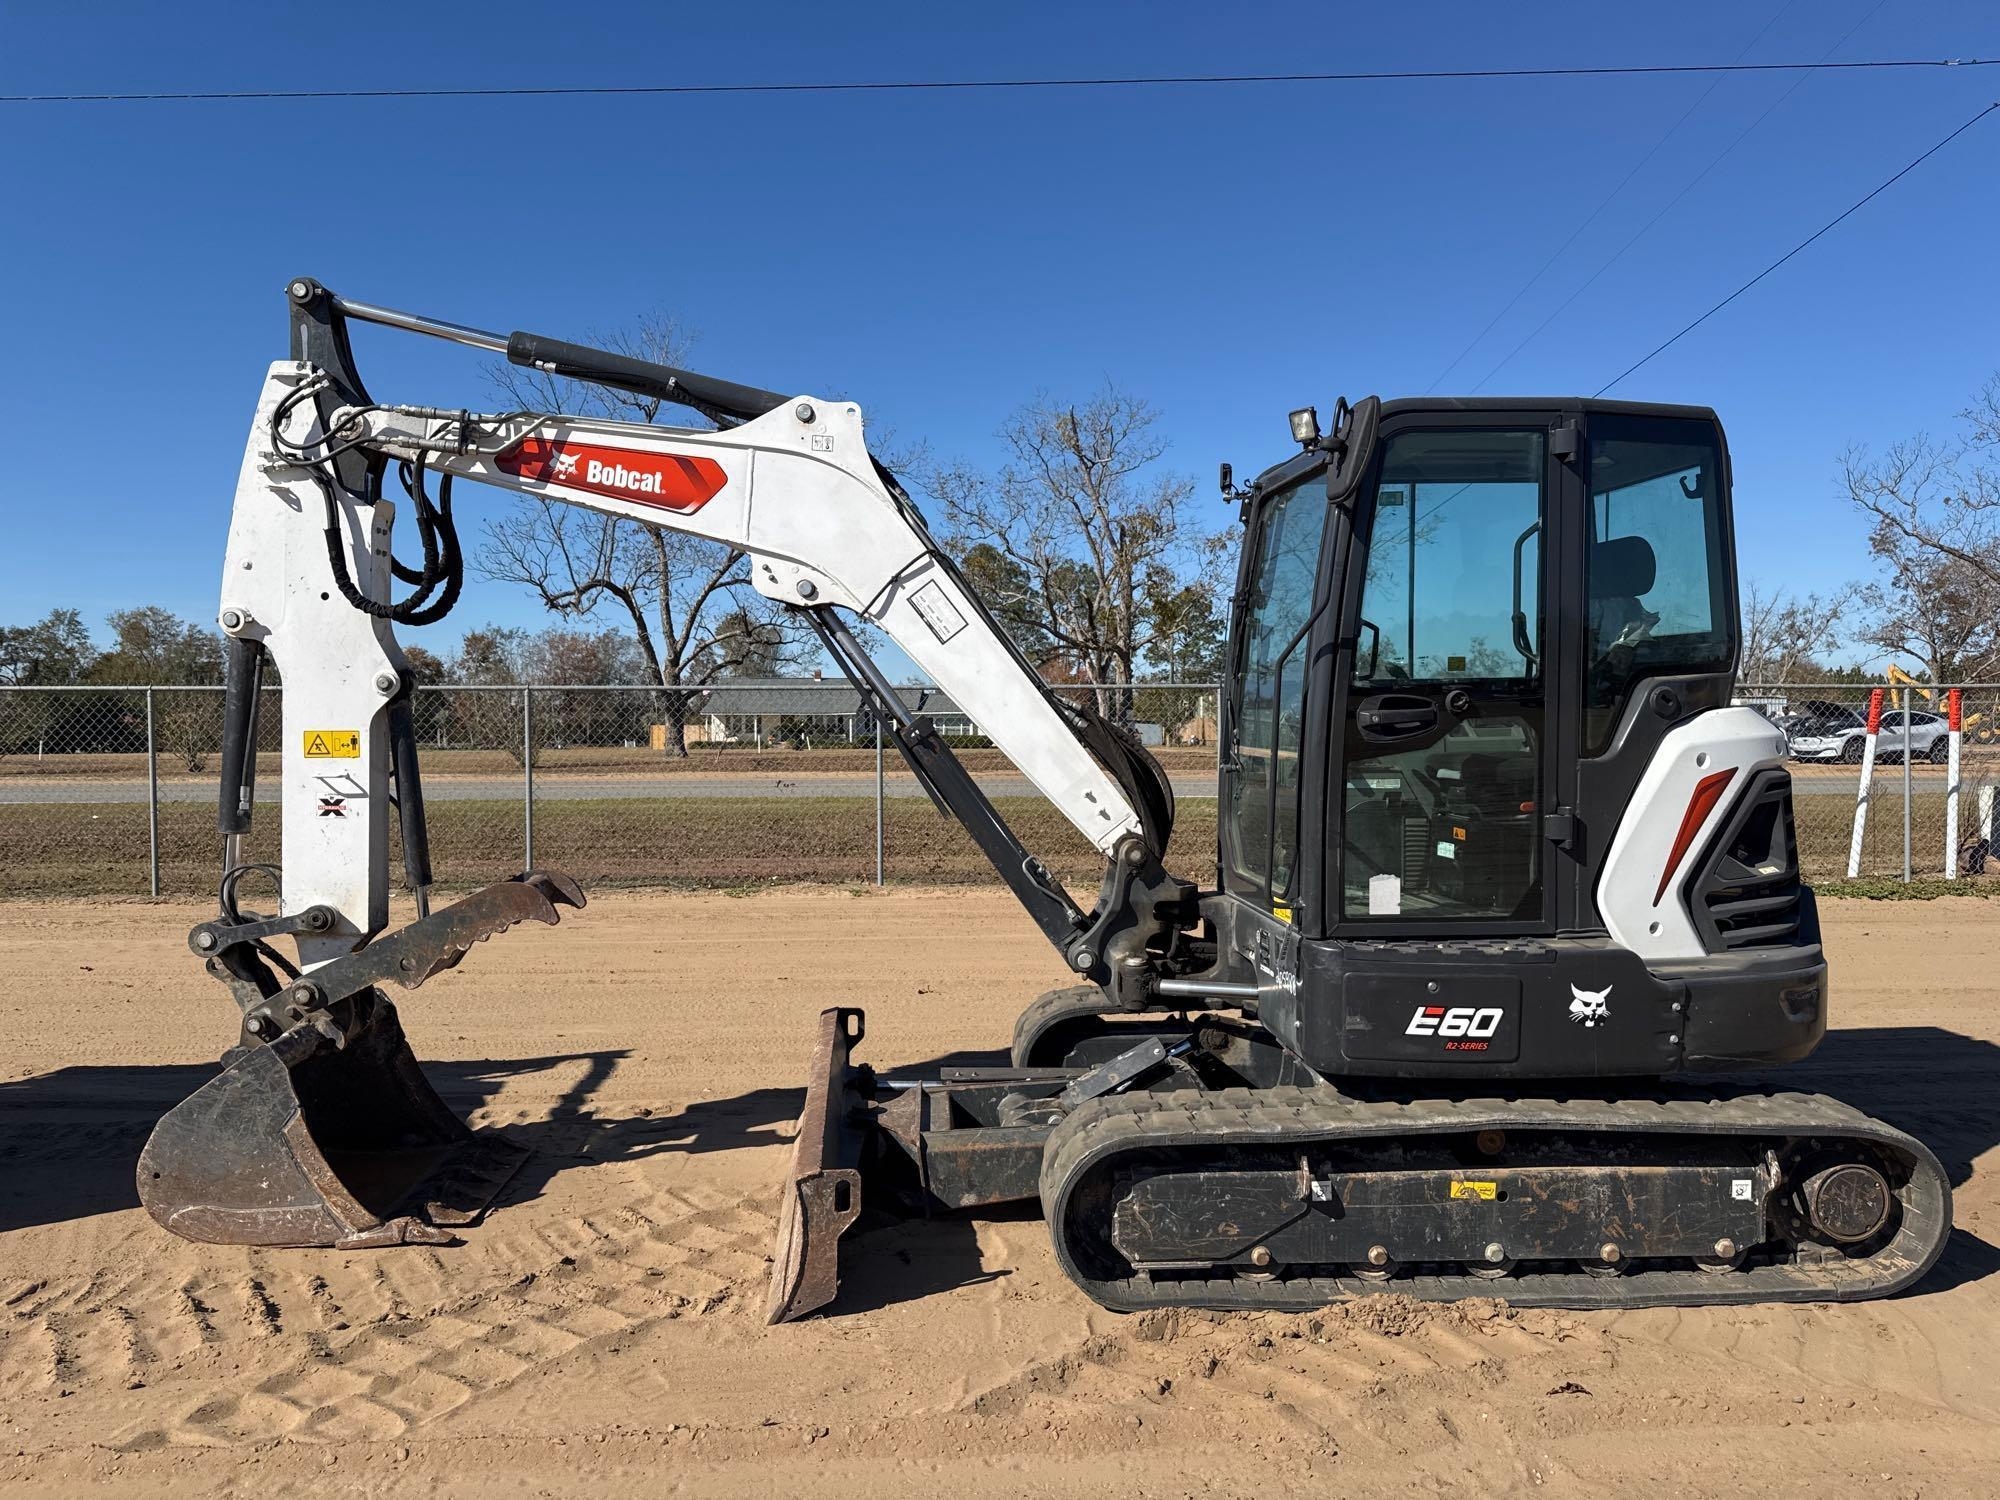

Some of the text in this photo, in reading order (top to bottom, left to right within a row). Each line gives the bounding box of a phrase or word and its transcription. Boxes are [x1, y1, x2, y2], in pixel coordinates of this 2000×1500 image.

[587, 460, 662, 493] Bobcat
[1405, 1005, 1504, 1037] E60
[1445, 1041, 1489, 1050] R2-SERIES
